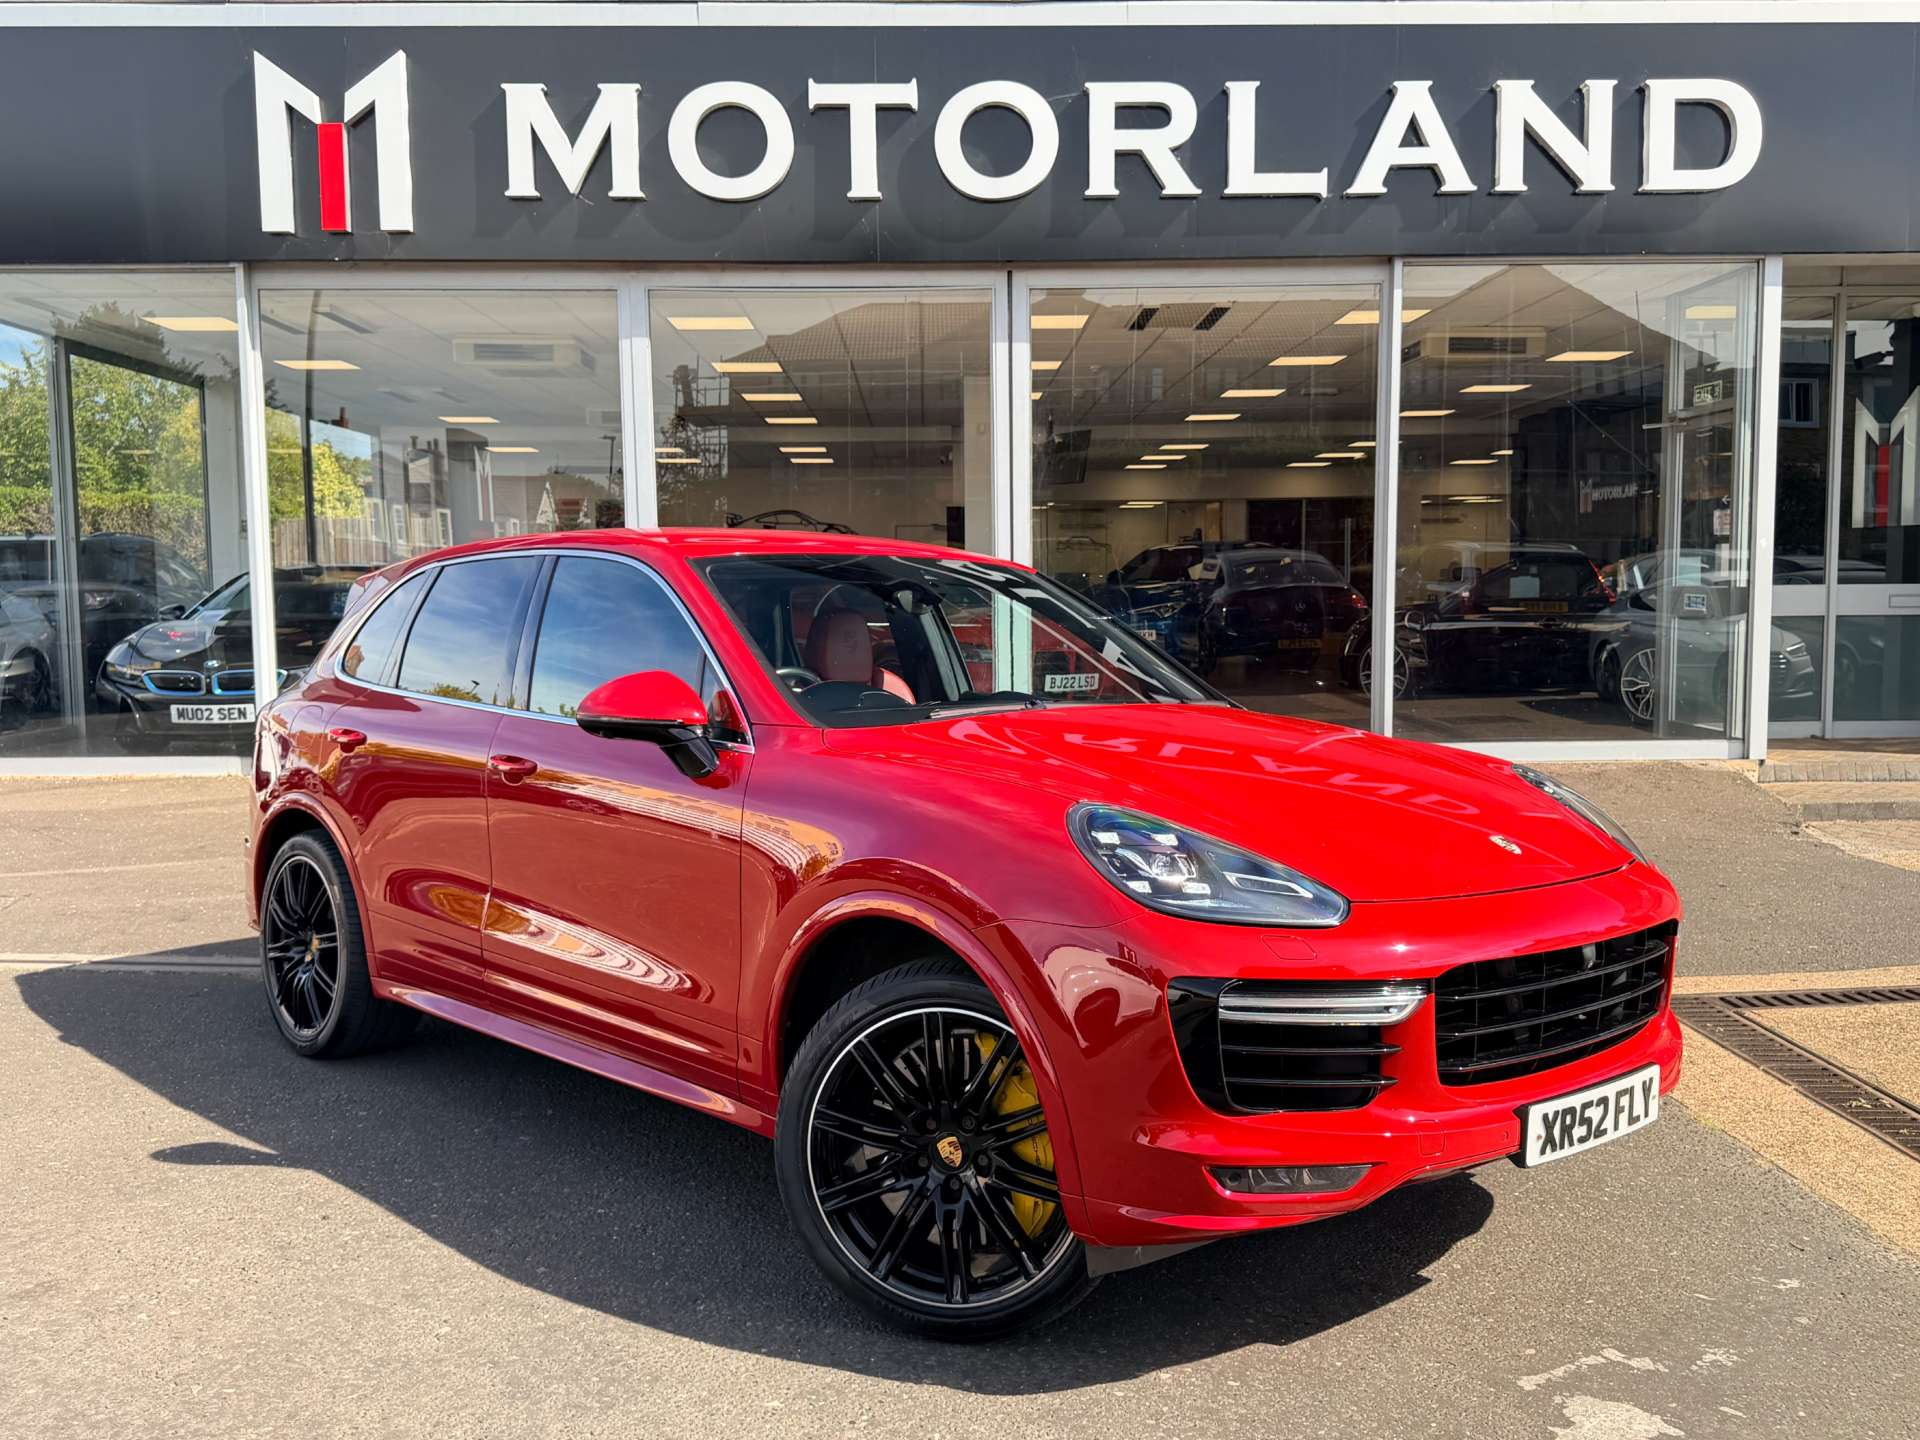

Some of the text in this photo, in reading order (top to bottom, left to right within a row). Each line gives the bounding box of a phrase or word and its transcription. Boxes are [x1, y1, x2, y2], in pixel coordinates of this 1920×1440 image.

[501, 77, 1765, 203] MOTORLAND
[1049, 676, 1076, 690] BJ22
[216, 706, 247, 721] SEN
[1540, 1076, 1654, 1156] XR52 FLY
